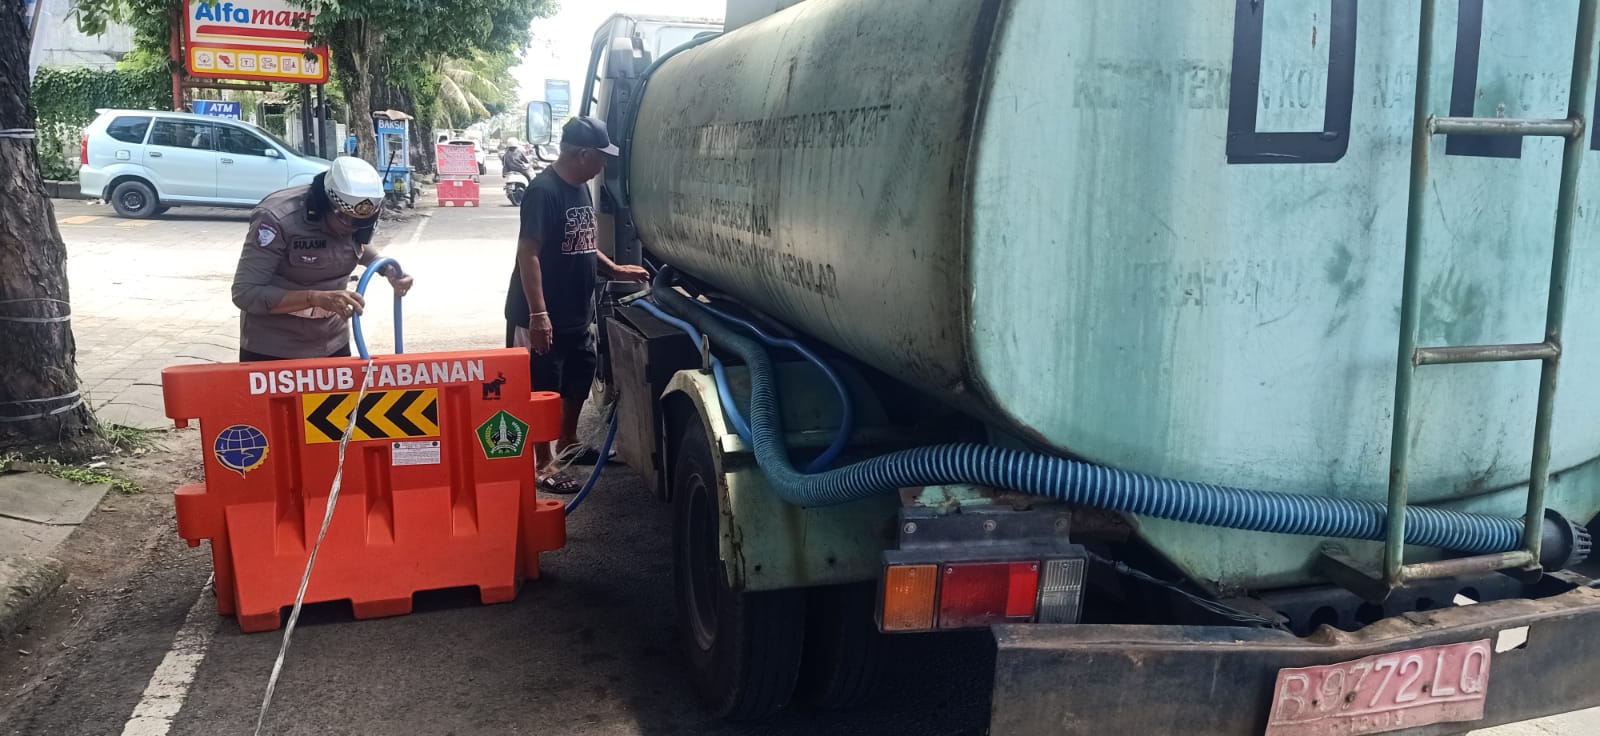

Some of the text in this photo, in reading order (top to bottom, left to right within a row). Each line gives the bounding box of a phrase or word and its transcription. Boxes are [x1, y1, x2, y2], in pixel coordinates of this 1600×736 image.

[209, 103, 233, 112] ATM
[249, 359, 485, 395] DISHUB TABANAN
